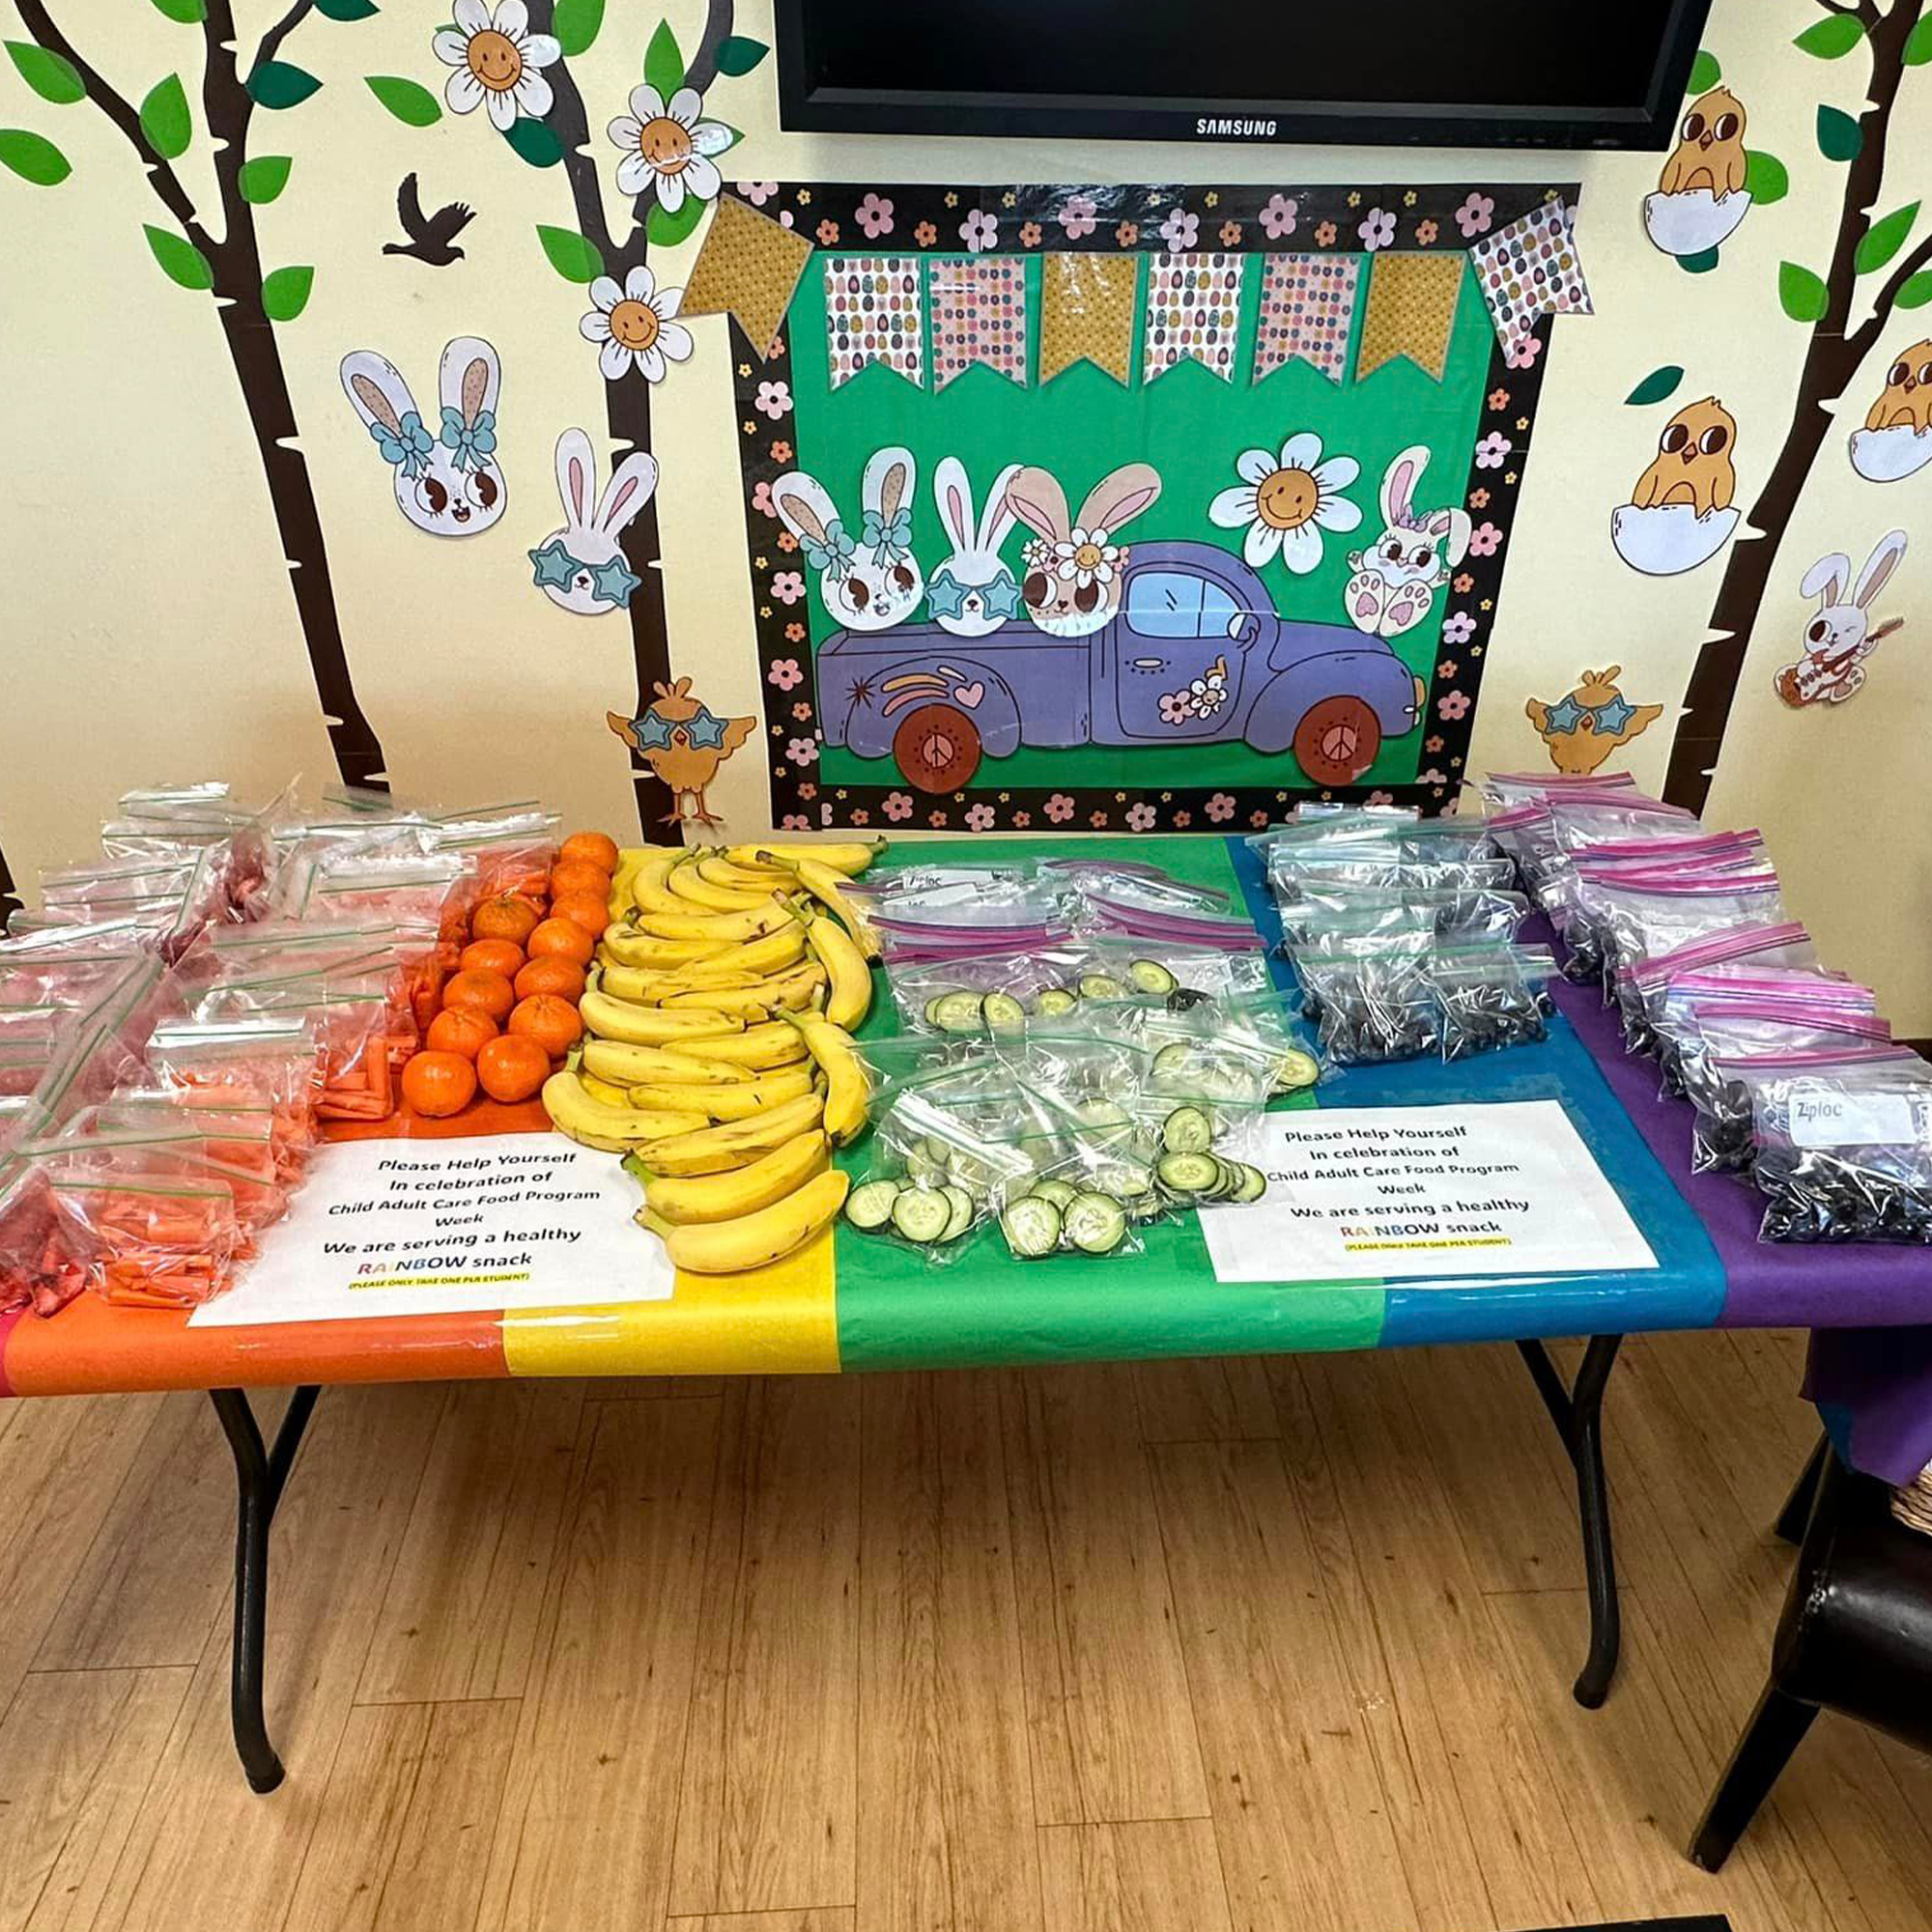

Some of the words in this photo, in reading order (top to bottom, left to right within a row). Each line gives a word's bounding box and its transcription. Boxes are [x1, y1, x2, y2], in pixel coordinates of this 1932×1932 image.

[1197, 118, 1277, 136] SAMSUNG
[1797, 1101, 1843, 1122] Ziploc
[1285, 1131, 1344, 1143] Please
[1347, 1128, 1390, 1141] Help
[1393, 1125, 1467, 1139] Yourself
[378, 1159, 441, 1172] Please
[446, 1156, 492, 1171] Help
[498, 1152, 577, 1165] Yourself
[1309, 1150, 1328, 1161] In
[1333, 1146, 1436, 1159] celebration
[1441, 1146, 1460, 1157] of
[389, 1179, 409, 1191] In
[414, 1174, 526, 1191] celebration
[531, 1170, 554, 1182] of
[1266, 1169, 1310, 1182] Child
[1315, 1166, 1360, 1179] Adult
[1363, 1165, 1402, 1178] Care
[1405, 1164, 1445, 1175] Food
[1448, 1163, 1520, 1176] Program
[1378, 1182, 1427, 1195] Week
[328, 1201, 374, 1215] Child
[378, 1199, 428, 1210] Adult
[433, 1199, 472, 1209] Care
[477, 1191, 521, 1206] Food
[526, 1190, 601, 1203] Program
[1291, 1208, 1323, 1219] We
[1329, 1208, 1360, 1218] are
[1364, 1202, 1436, 1217] serving
[1441, 1204, 1453, 1213] a
[1456, 1198, 1530, 1213] healthy
[436, 1213, 485, 1228] Week
[1445, 1221, 1503, 1234] snack
[324, 1242, 356, 1254] We
[362, 1241, 396, 1253] are
[402, 1235, 478, 1251] serving
[484, 1234, 497, 1244] a
[503, 1228, 582, 1244] healthy
[357, 1256, 468, 1275] RAINBOW
[472, 1252, 532, 1268] snack
[387, 1278, 414, 1287] ONLY
